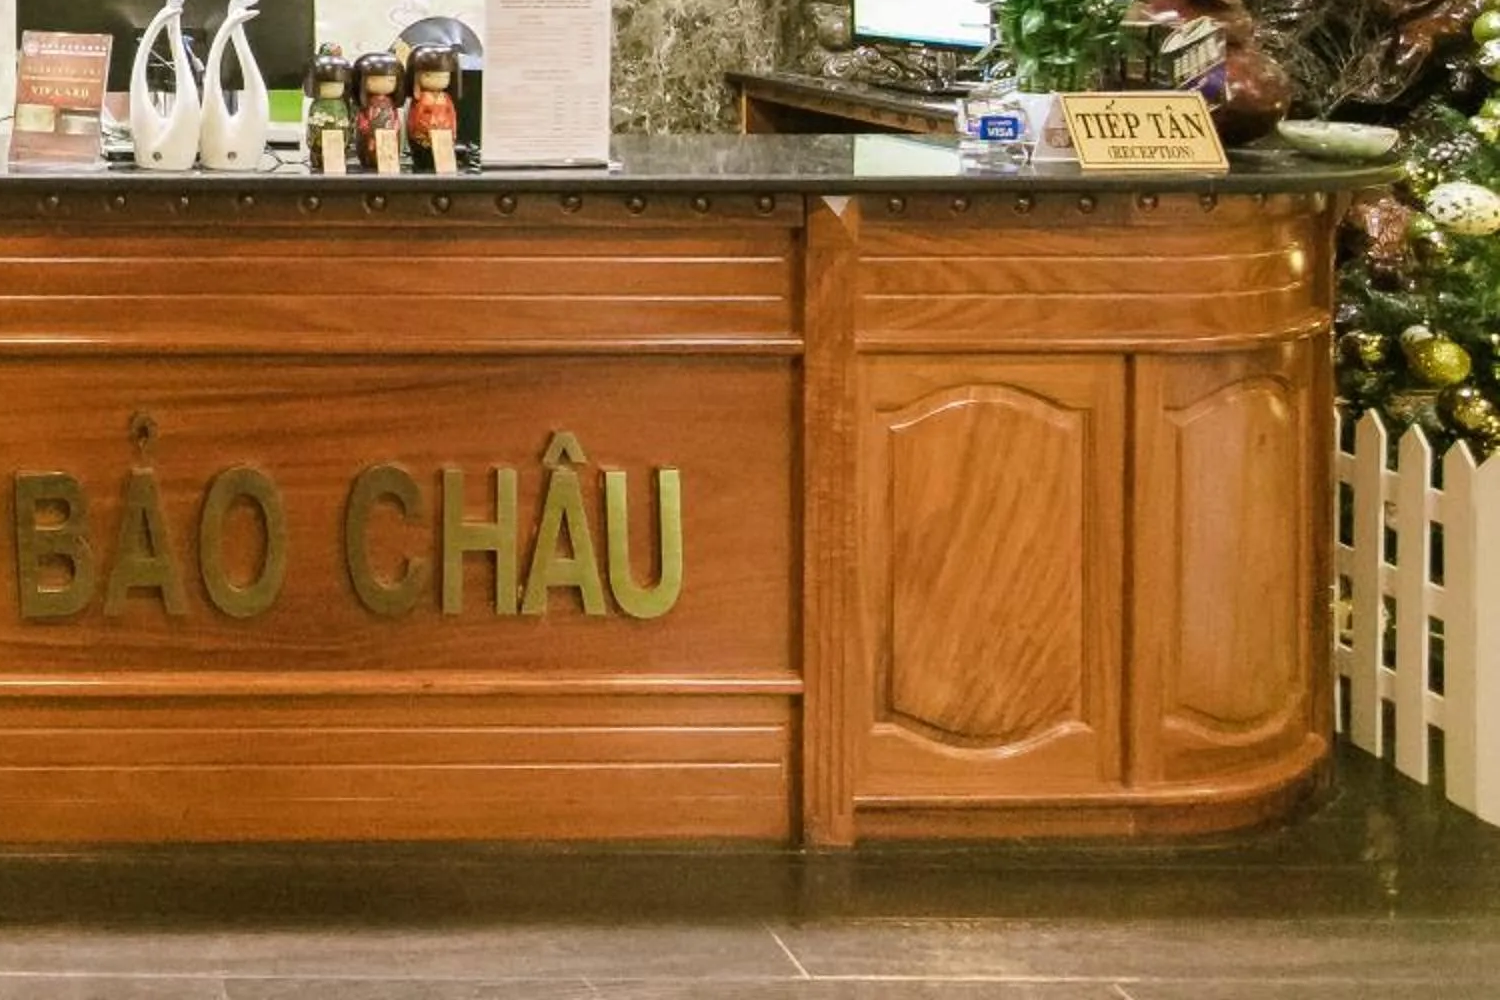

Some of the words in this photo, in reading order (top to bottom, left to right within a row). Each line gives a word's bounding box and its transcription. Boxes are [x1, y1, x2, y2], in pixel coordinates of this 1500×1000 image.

[987, 126, 1014, 137] VISA
[1075, 100, 1140, 139] TIẾP
[1146, 104, 1205, 139] TÂN
[1107, 144, 1195, 160] (RECEPTION)
[16, 411, 286, 619] BẢO
[346, 430, 684, 619] CHÂU
